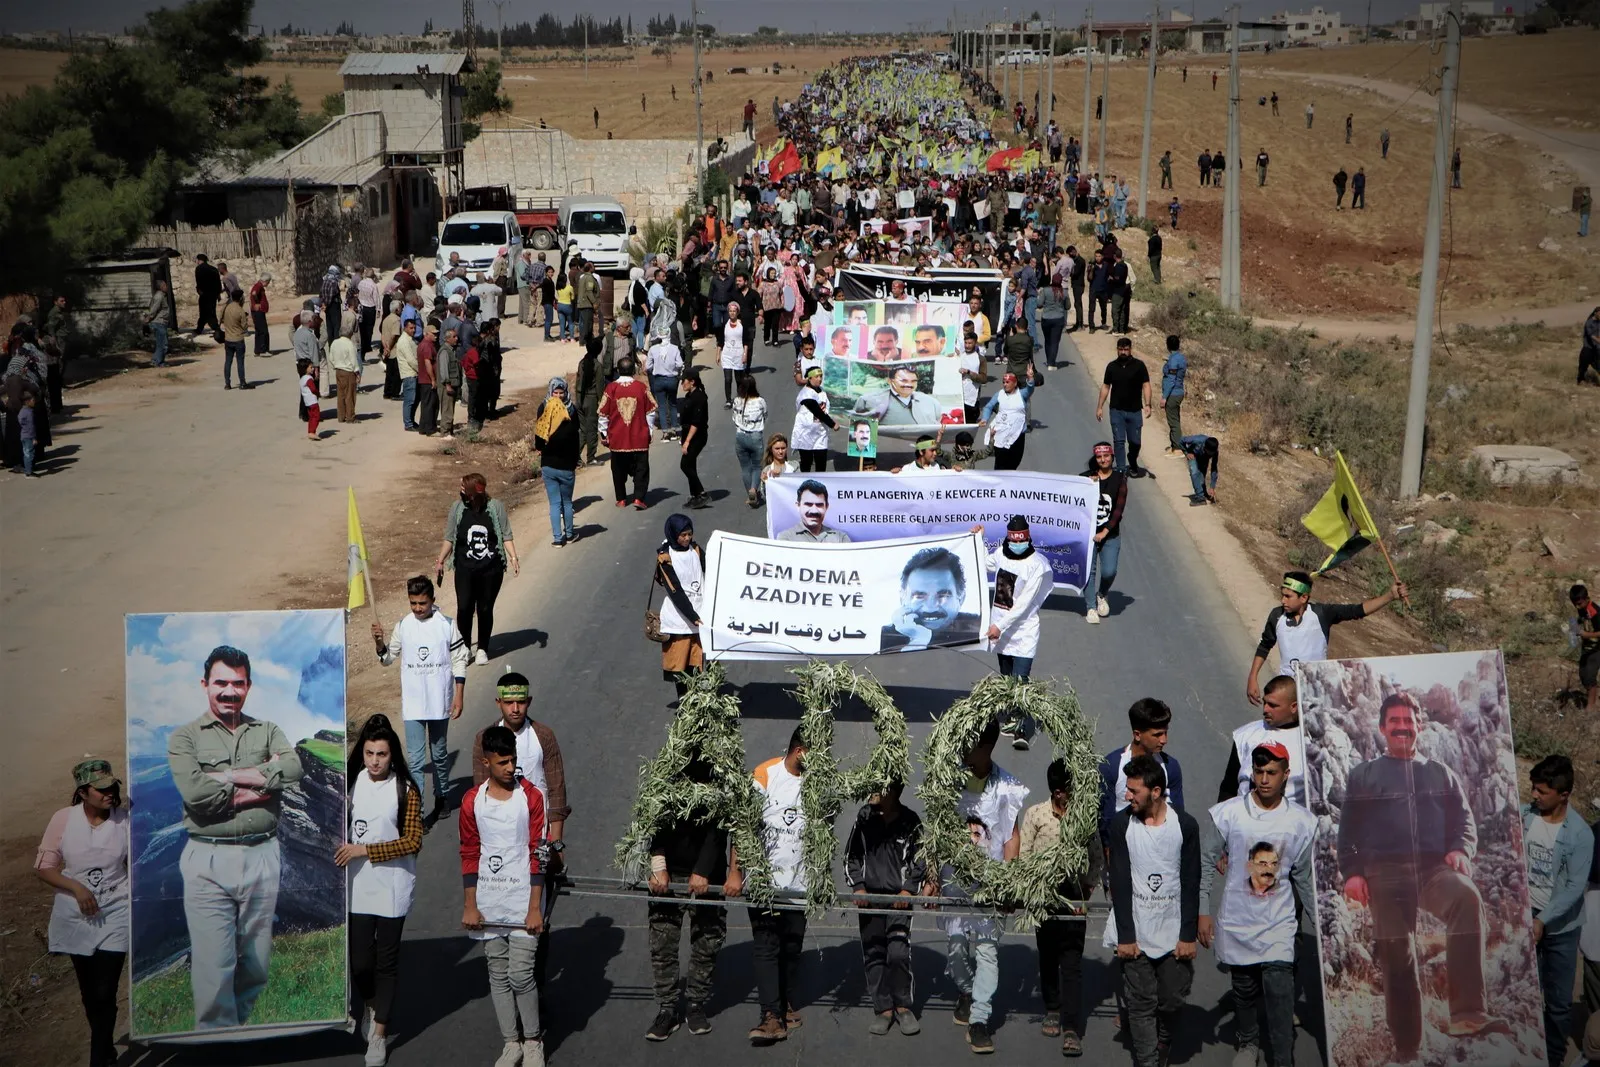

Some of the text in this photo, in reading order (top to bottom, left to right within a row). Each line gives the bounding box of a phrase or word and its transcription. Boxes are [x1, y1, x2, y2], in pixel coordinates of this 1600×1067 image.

[837, 490, 854, 500] EM
[999, 488, 1007, 498] A
[1073, 496, 1087, 508] YA
[849, 514, 868, 524] SER
[908, 514, 942, 524] GELAN
[944, 513, 977, 523] SEROK
[979, 513, 1001, 522] APO
[1056, 518, 1081, 531] DIKIN
[745, 560, 862, 586] DEM DEMA
[739, 585, 864, 608] AZADIYE YÊ
[727, 616, 867, 642] حان وقت الحرية
